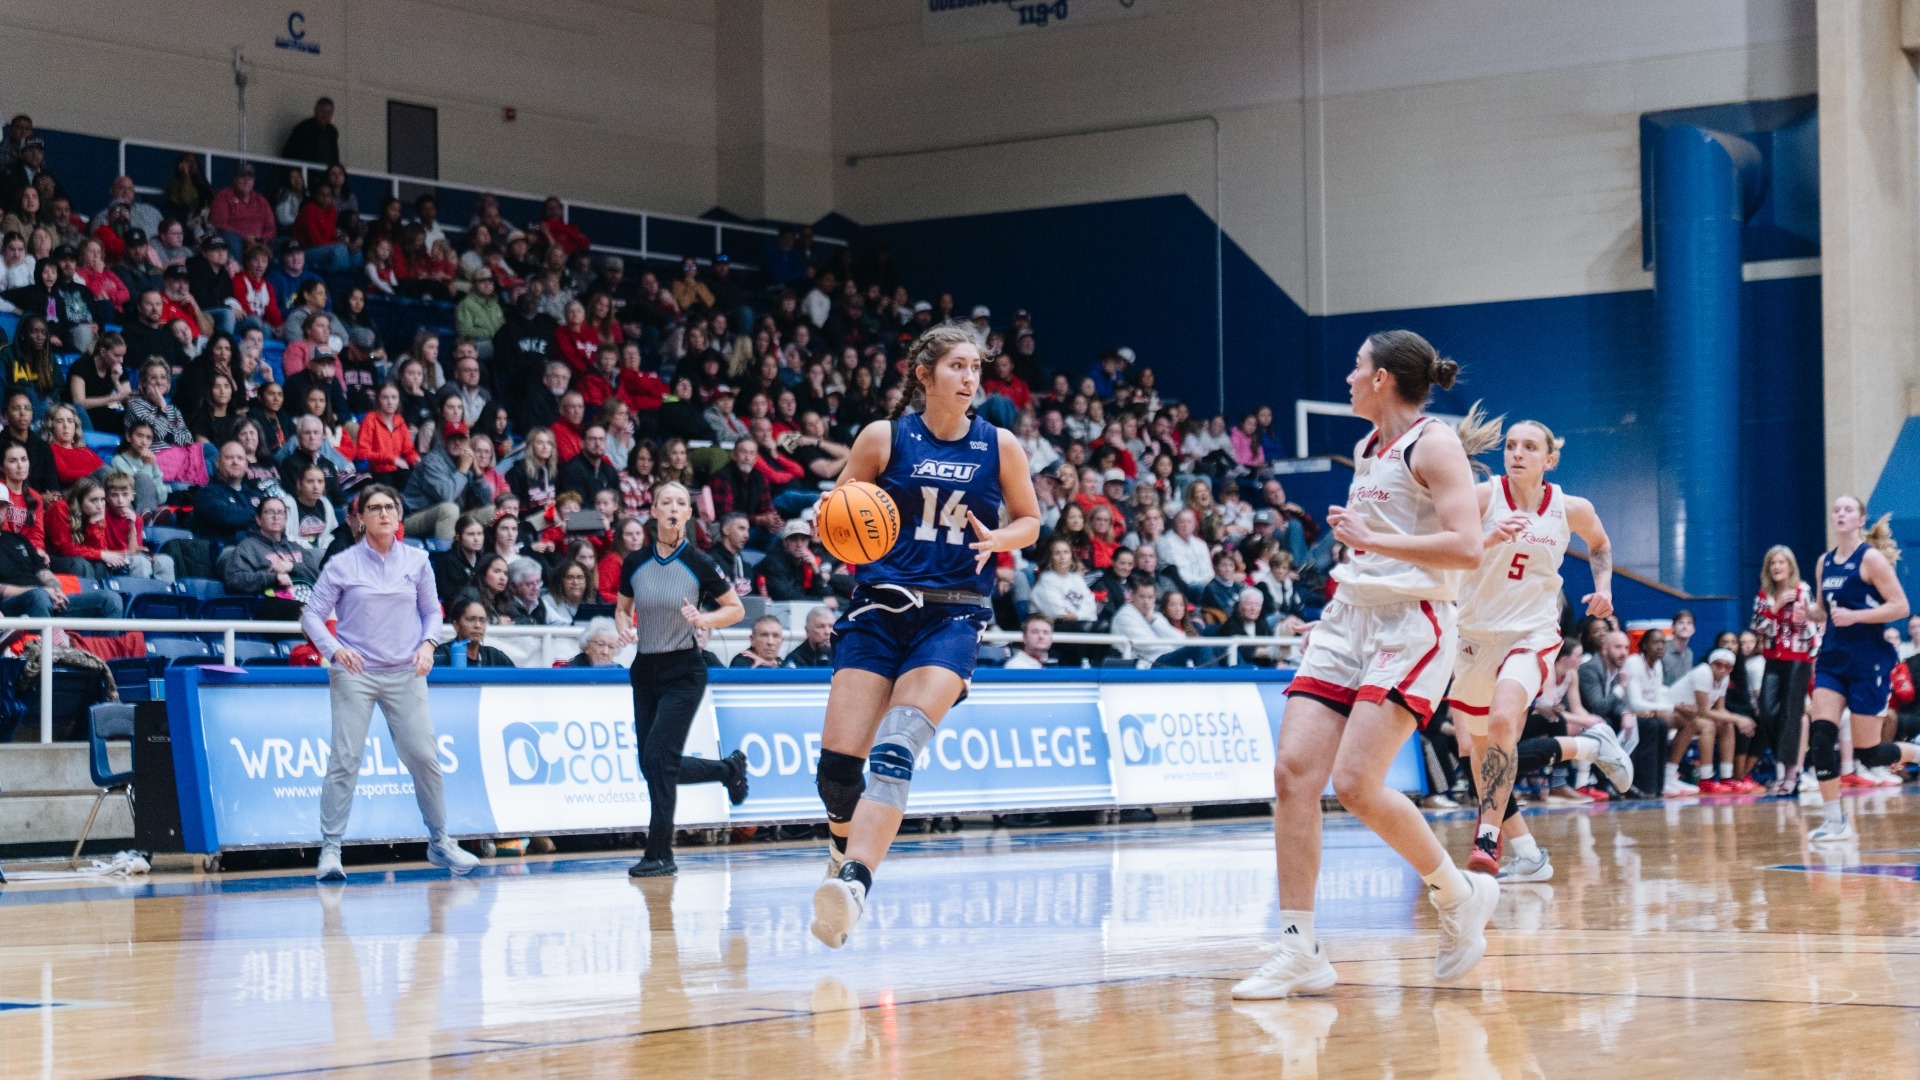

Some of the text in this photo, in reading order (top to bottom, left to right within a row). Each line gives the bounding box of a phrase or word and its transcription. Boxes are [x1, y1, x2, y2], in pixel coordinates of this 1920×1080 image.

[288, 11, 305, 40] C
[914, 460, 976, 481] ACU
[914, 486, 968, 545] 14
[1508, 553, 1529, 580] 5
[1161, 713, 1244, 738] ODESSA
[935, 726, 1096, 771] COLLEGE
[1165, 738, 1261, 766] COLLEGE
